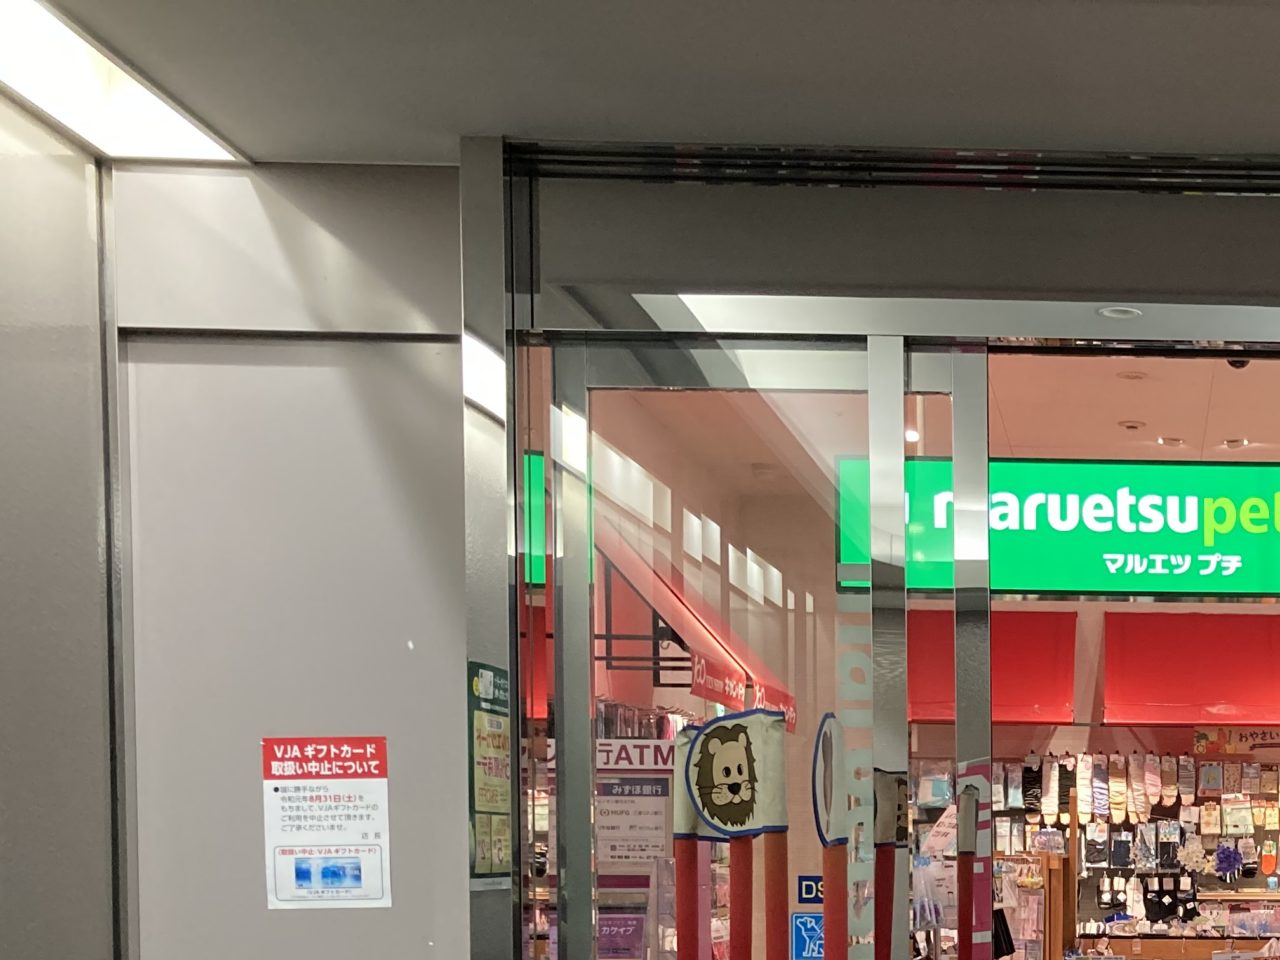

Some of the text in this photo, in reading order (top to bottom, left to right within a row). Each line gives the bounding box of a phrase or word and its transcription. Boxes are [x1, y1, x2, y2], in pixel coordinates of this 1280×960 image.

[1103, 552, 1243, 576] マルエツ プチ
[273, 744, 376, 759] VJA ギフトカード
[271, 760, 380, 775] 取扱い中止について
